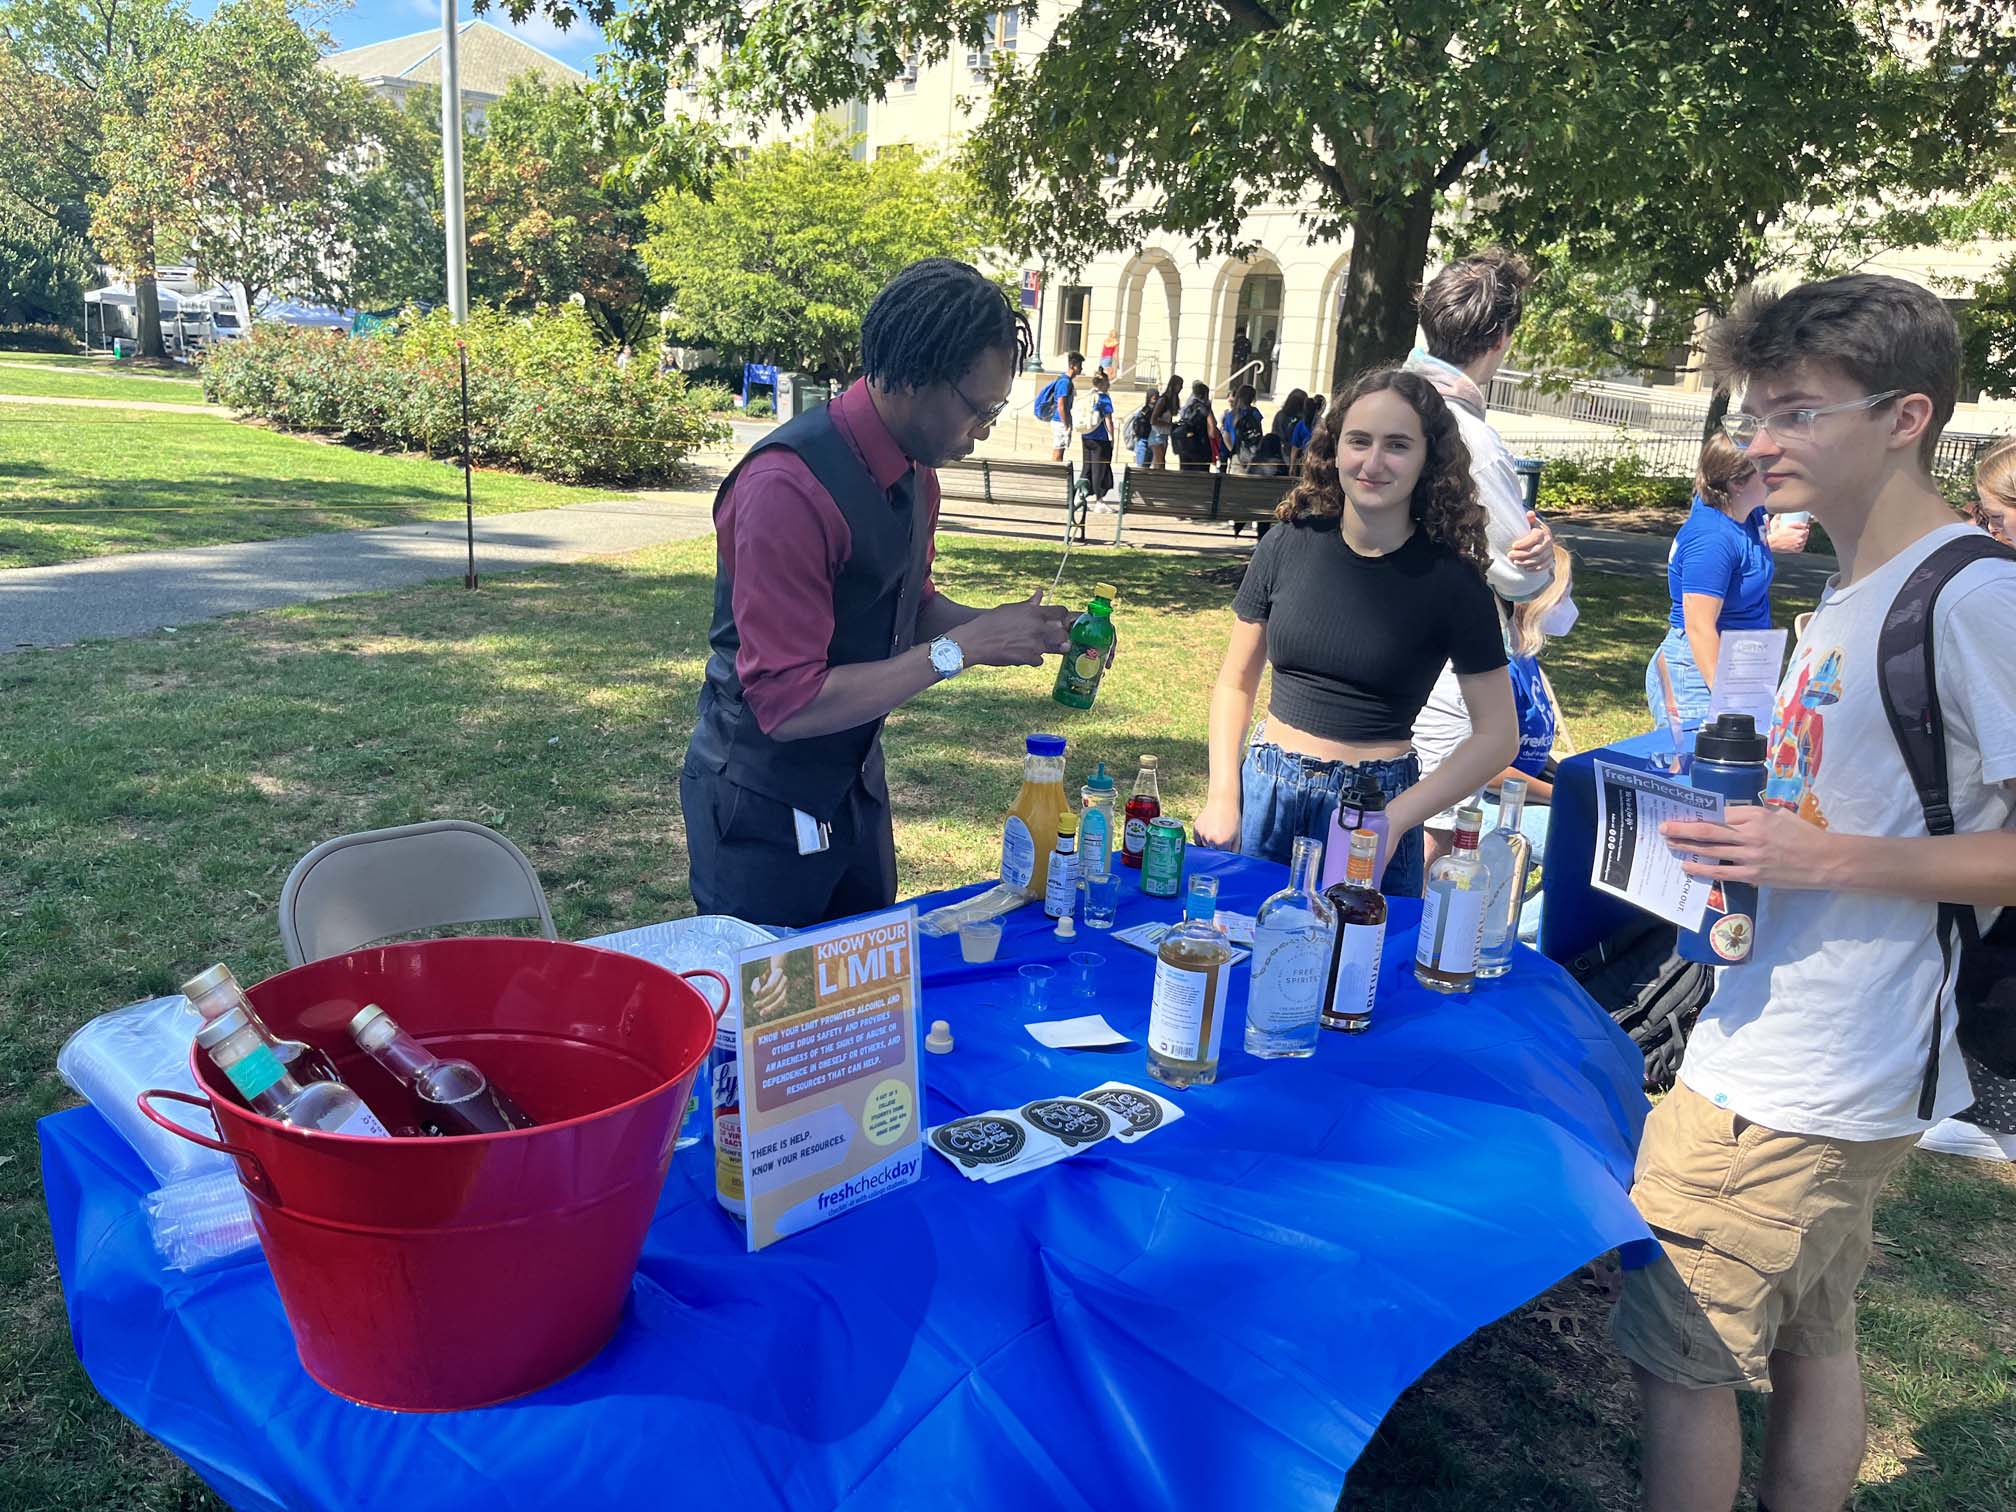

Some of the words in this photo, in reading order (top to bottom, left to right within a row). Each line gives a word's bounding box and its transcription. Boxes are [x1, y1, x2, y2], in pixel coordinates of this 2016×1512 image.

[1603, 768, 1714, 807] freshcheckday
[818, 934, 866, 960] KNOW
[867, 924, 906, 946] YOUR
[818, 940, 907, 996] LIMIT
[758, 1031, 779, 1046] KNOW
[780, 1026, 799, 1039] YOUR
[801, 1019, 819, 1032] LIMIT
[820, 1008, 856, 1026] PROMOTES
[857, 999, 886, 1014] ALCOHOL
[887, 994, 900, 1006] AND
[772, 1043, 795, 1056] OTHER
[797, 1036, 816, 1048] DRUG
[816, 1026, 843, 1041] SAFETY
[844, 1021, 858, 1033] AND
[860, 1011, 890, 1028] PROVIDES
[762, 1066, 809, 1089] DEPENDENCE
[810, 1062, 817, 1072] IN
[818, 1052, 848, 1070] ONESELF
[849, 1048, 858, 1058] OR
[888, 1035, 901, 1046] AND
[765, 1052, 808, 1072] AWARENESS
[810, 1048, 819, 1058] OF
[820, 1043, 834, 1054] THE
[836, 1037, 854, 1050] SIGNS
[856, 1033, 865, 1043] OF
[866, 1026, 888, 1040] ABUSE
[888, 1022, 897, 1032] OR
[786, 1075, 826, 1096] RESOURCES
[828, 1068, 846, 1081] THAT
[848, 1062, 862, 1074] CAN
[863, 1056, 881, 1069] HELP.
[752, 1143, 778, 1160] THERE
[780, 1139, 788, 1150] IS
[790, 1130, 812, 1146] HELP.
[752, 1162, 774, 1176] KNOW
[778, 1152, 798, 1168] YOUR
[800, 1134, 846, 1158] RESOURCES.
[818, 1158, 918, 1210] freshcheckday
